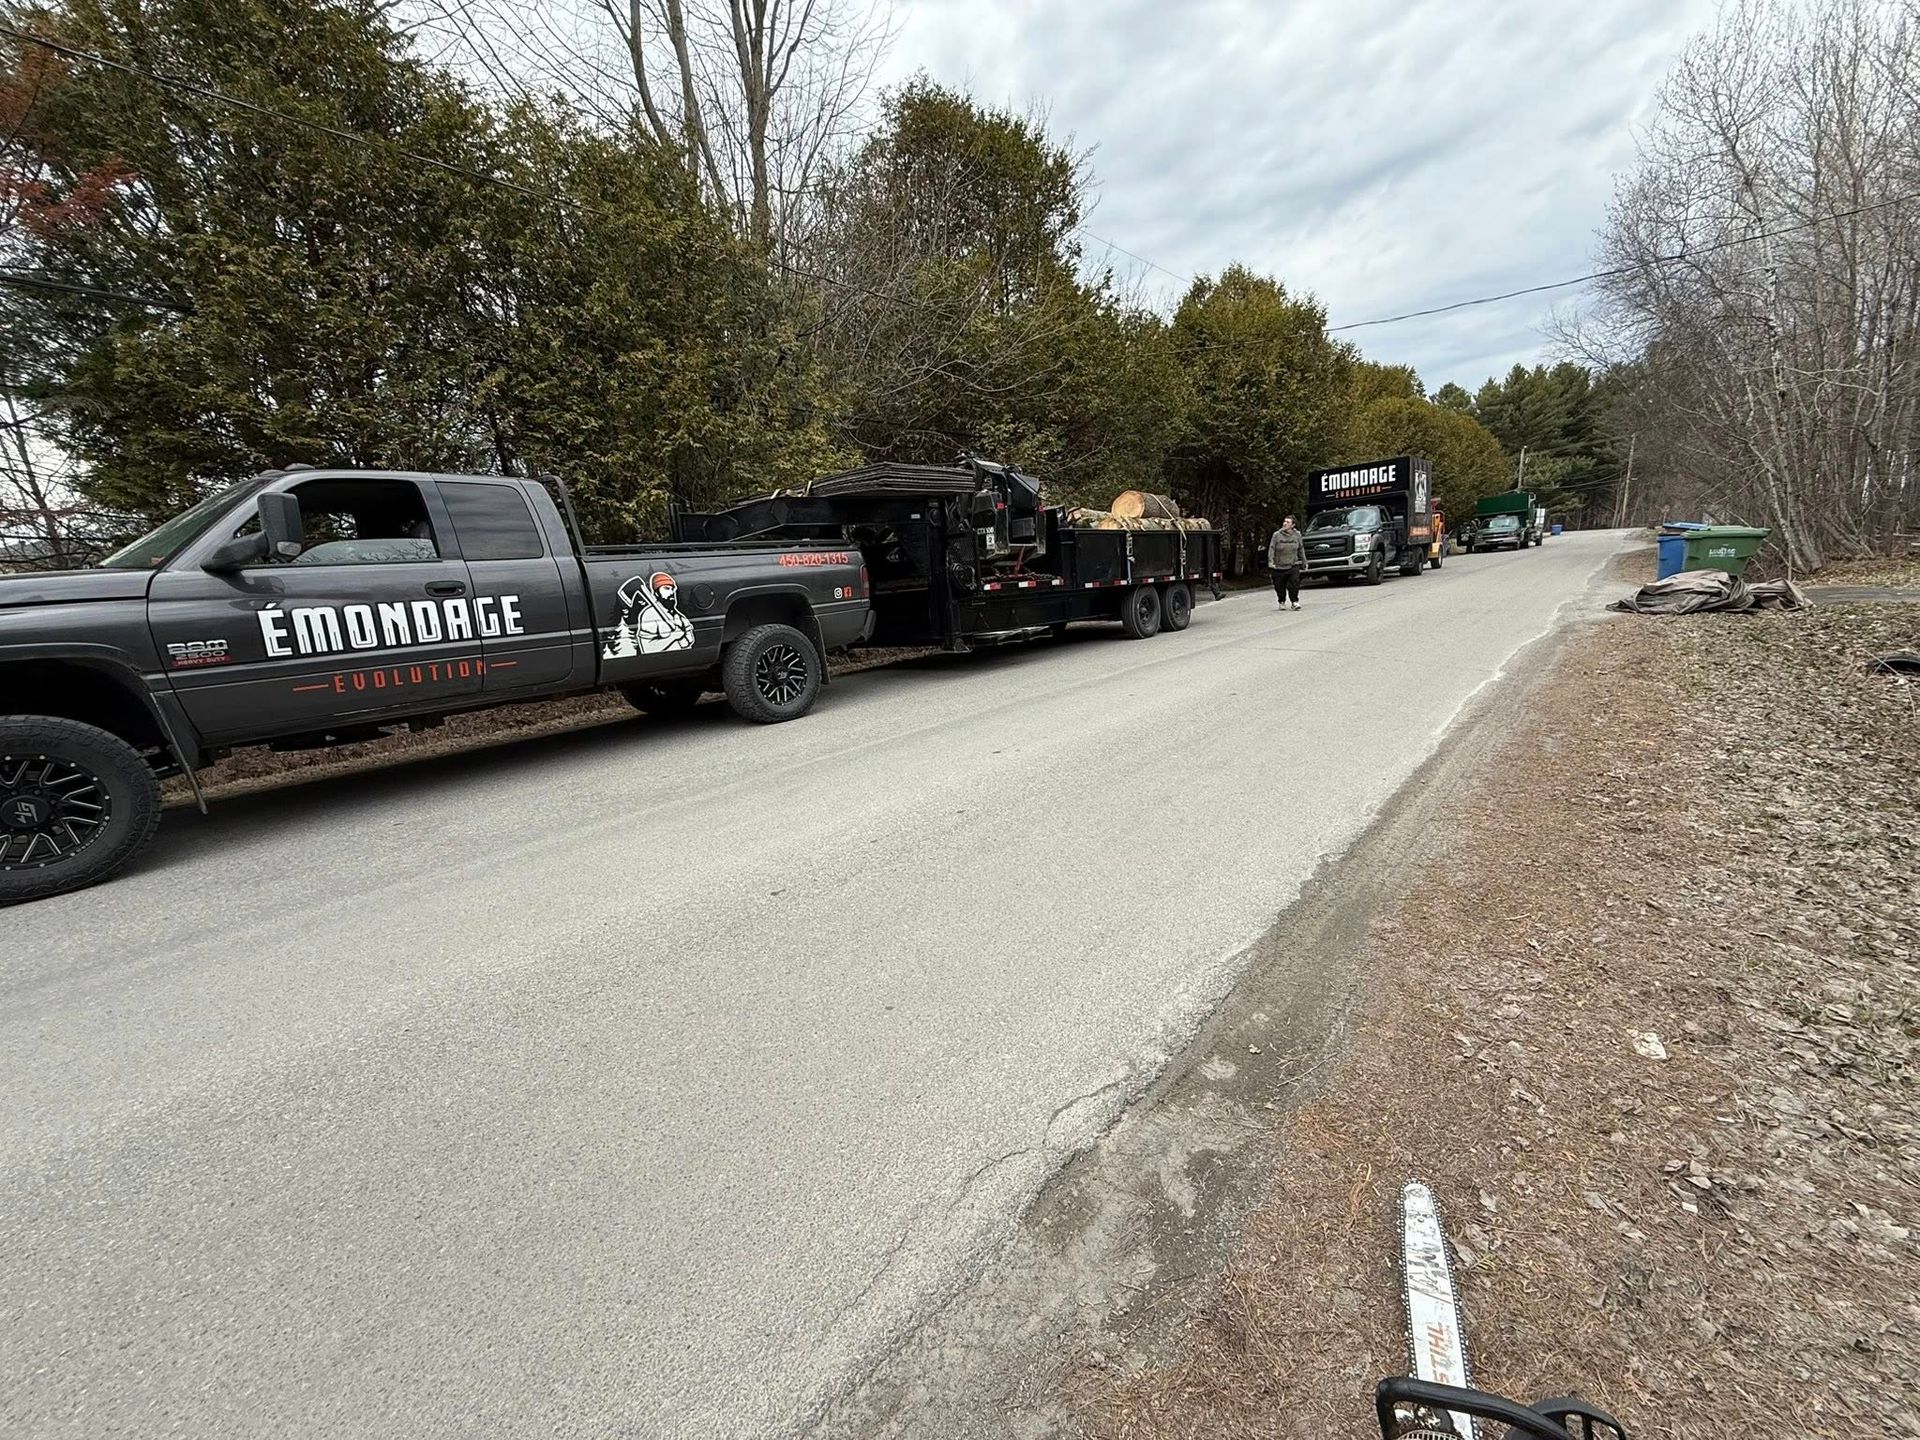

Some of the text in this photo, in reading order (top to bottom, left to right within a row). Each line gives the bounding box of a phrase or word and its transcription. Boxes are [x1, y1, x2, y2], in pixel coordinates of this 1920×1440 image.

[1321, 465, 1396, 491] ÉMONDAGE
[779, 552, 849, 567] 450-820-1315
[257, 594, 525, 658] ÉMONDAGE
[334, 660, 487, 693] EVOLUTION
[1427, 1321, 1450, 1384] STIHL
